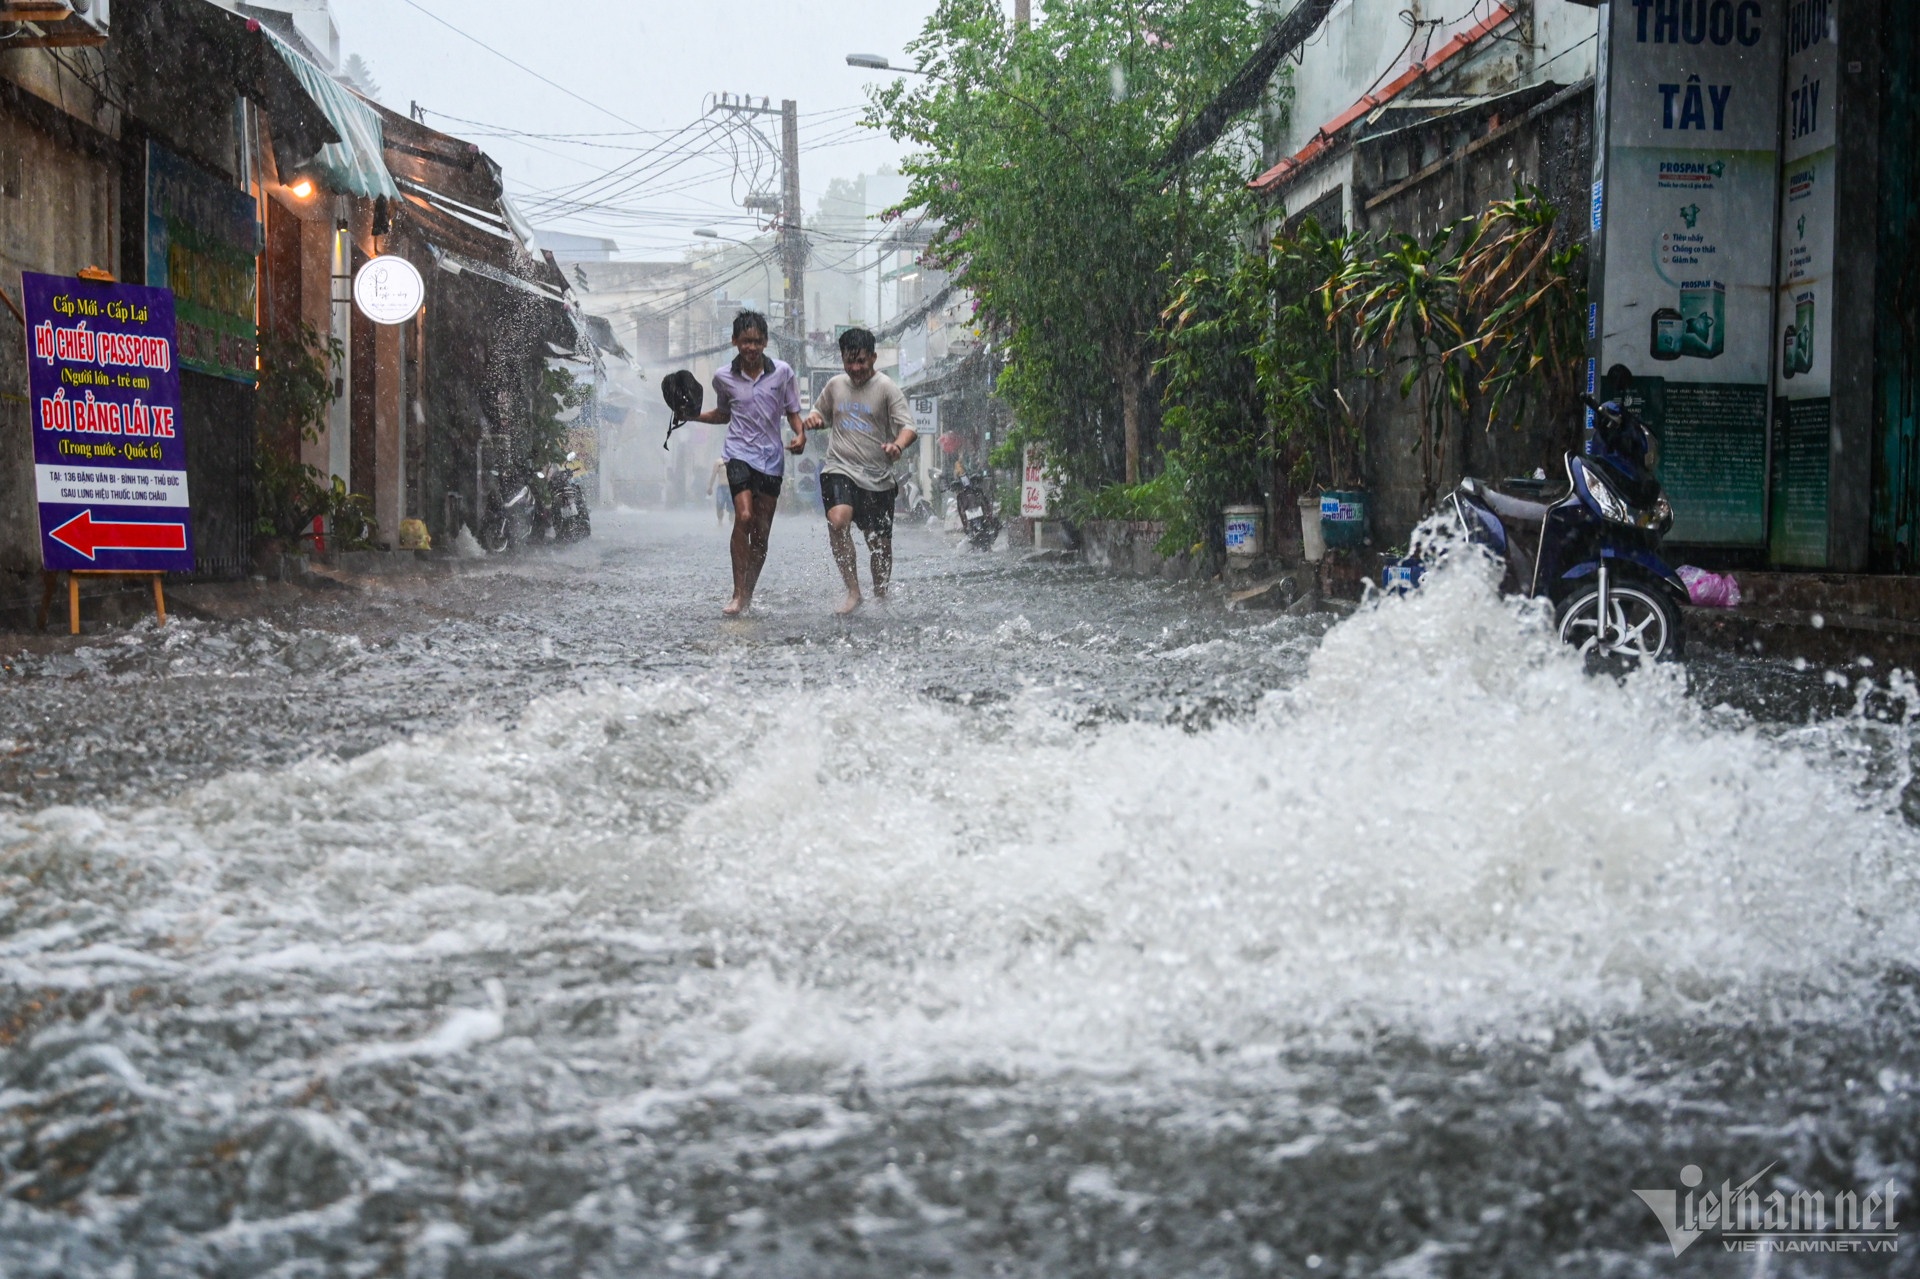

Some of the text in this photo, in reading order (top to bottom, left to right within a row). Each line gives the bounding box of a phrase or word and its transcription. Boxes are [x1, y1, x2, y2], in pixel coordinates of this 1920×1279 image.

[1658, 74, 1732, 131] TÂY
[1791, 74, 1821, 141] TÂY
[1660, 162, 1705, 174] PROSPAN
[1690, 256, 1699, 264] ho
[53, 294, 75, 317] Cấp
[77, 298, 98, 316] Mới
[107, 301, 128, 322] Cấp
[131, 304, 148, 324] Lại
[35, 320, 55, 365] HỘ
[56, 320, 95, 363] CHIẾU
[97, 332, 171, 372] (PASSPORT)
[61, 368, 93, 387] (Người
[95, 368, 109, 385] lớn
[117, 372, 131, 388] trẻ
[132, 376, 150, 390] em)
[41, 387, 175, 438] ĐỔI BẰNG LÁI XE
[59, 439, 92, 458] (Trong
[94, 441, 116, 456] nước
[124, 442, 148, 461] Quốc
[150, 442, 162, 460] tế)
[64, 472, 76, 482] 136
[77, 471, 94, 484] ĐẶNG
[95, 472, 108, 483] VĂN
[109, 474, 116, 483] BI
[121, 473, 136, 484] BÌNH
[137, 475, 149, 486] THỌ
[154, 474, 166, 485] THỦ
[167, 475, 179, 486] ĐỨC
[61, 488, 76, 498] (SAU
[95, 488, 109, 501] HIỆU
[111, 488, 131, 500] THUỐC
[132, 490, 147, 500] LONG
